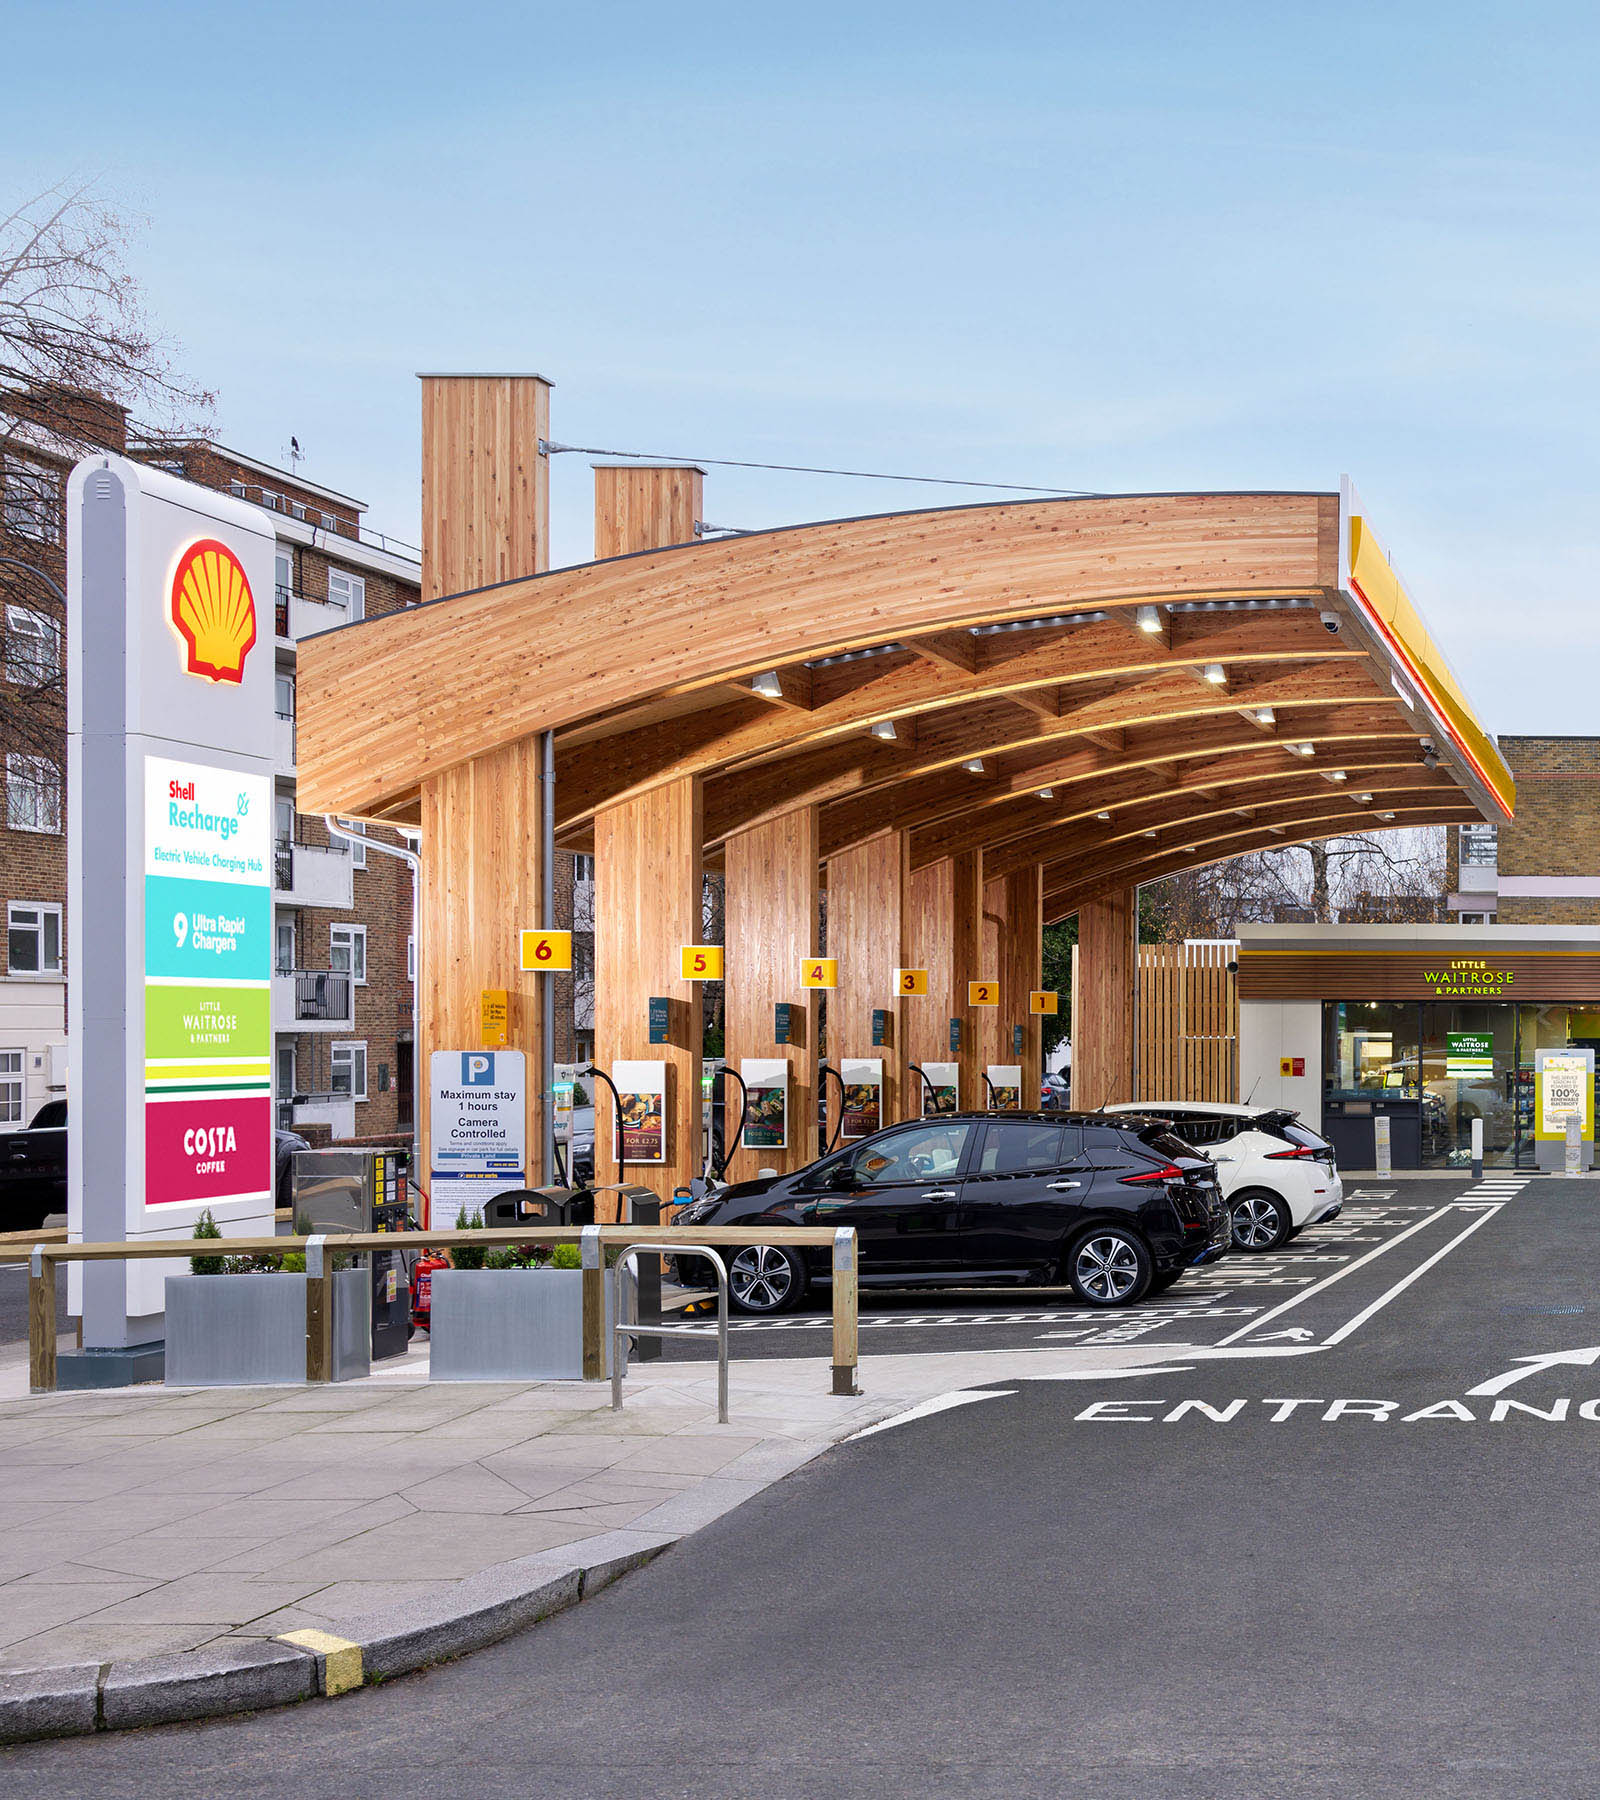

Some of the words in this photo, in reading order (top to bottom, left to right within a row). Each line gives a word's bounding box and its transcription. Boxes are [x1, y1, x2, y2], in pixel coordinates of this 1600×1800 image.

[169, 780, 194, 801] Shell
[169, 802, 238, 840] Recharge
[154, 847, 181, 864] Electric
[183, 850, 210, 866] Vehicle
[212, 854, 245, 873] Charging
[248, 858, 263, 872] Hub
[173, 912, 188, 948] 9
[192, 913, 216, 932] Ultra
[218, 915, 245, 936] Rapid
[192, 931, 237, 954] Chargers
[535, 939, 552, 961] 6
[693, 954, 707, 972] 5
[1451, 961, 1486, 969] LITTLE
[811, 965, 824, 981] 4
[1424, 972, 1514, 984] WAITROSE
[903, 975, 915, 990] 3
[978, 987, 988, 1001] 2
[1436, 987, 1442, 995] &
[1446, 987, 1502, 995] PARTNERS
[200, 1002, 221, 1012] LITTLE
[1039, 997, 1045, 1009] 1
[183, 1015, 237, 1030] WAITROSE
[196, 1033, 230, 1044] PARTNERS
[469, 1056, 490, 1083] P
[440, 1090, 491, 1100] Maximum
[494, 1091, 517, 1101] stay
[1550, 1088, 1580, 1098] 100%
[459, 1102, 464, 1111] 1
[467, 1102, 498, 1111] hours
[458, 1117, 499, 1127] Camera
[450, 1129, 506, 1139] Controlled
[183, 1126, 237, 1158] COSTA
[196, 1160, 226, 1175] COFFEE
